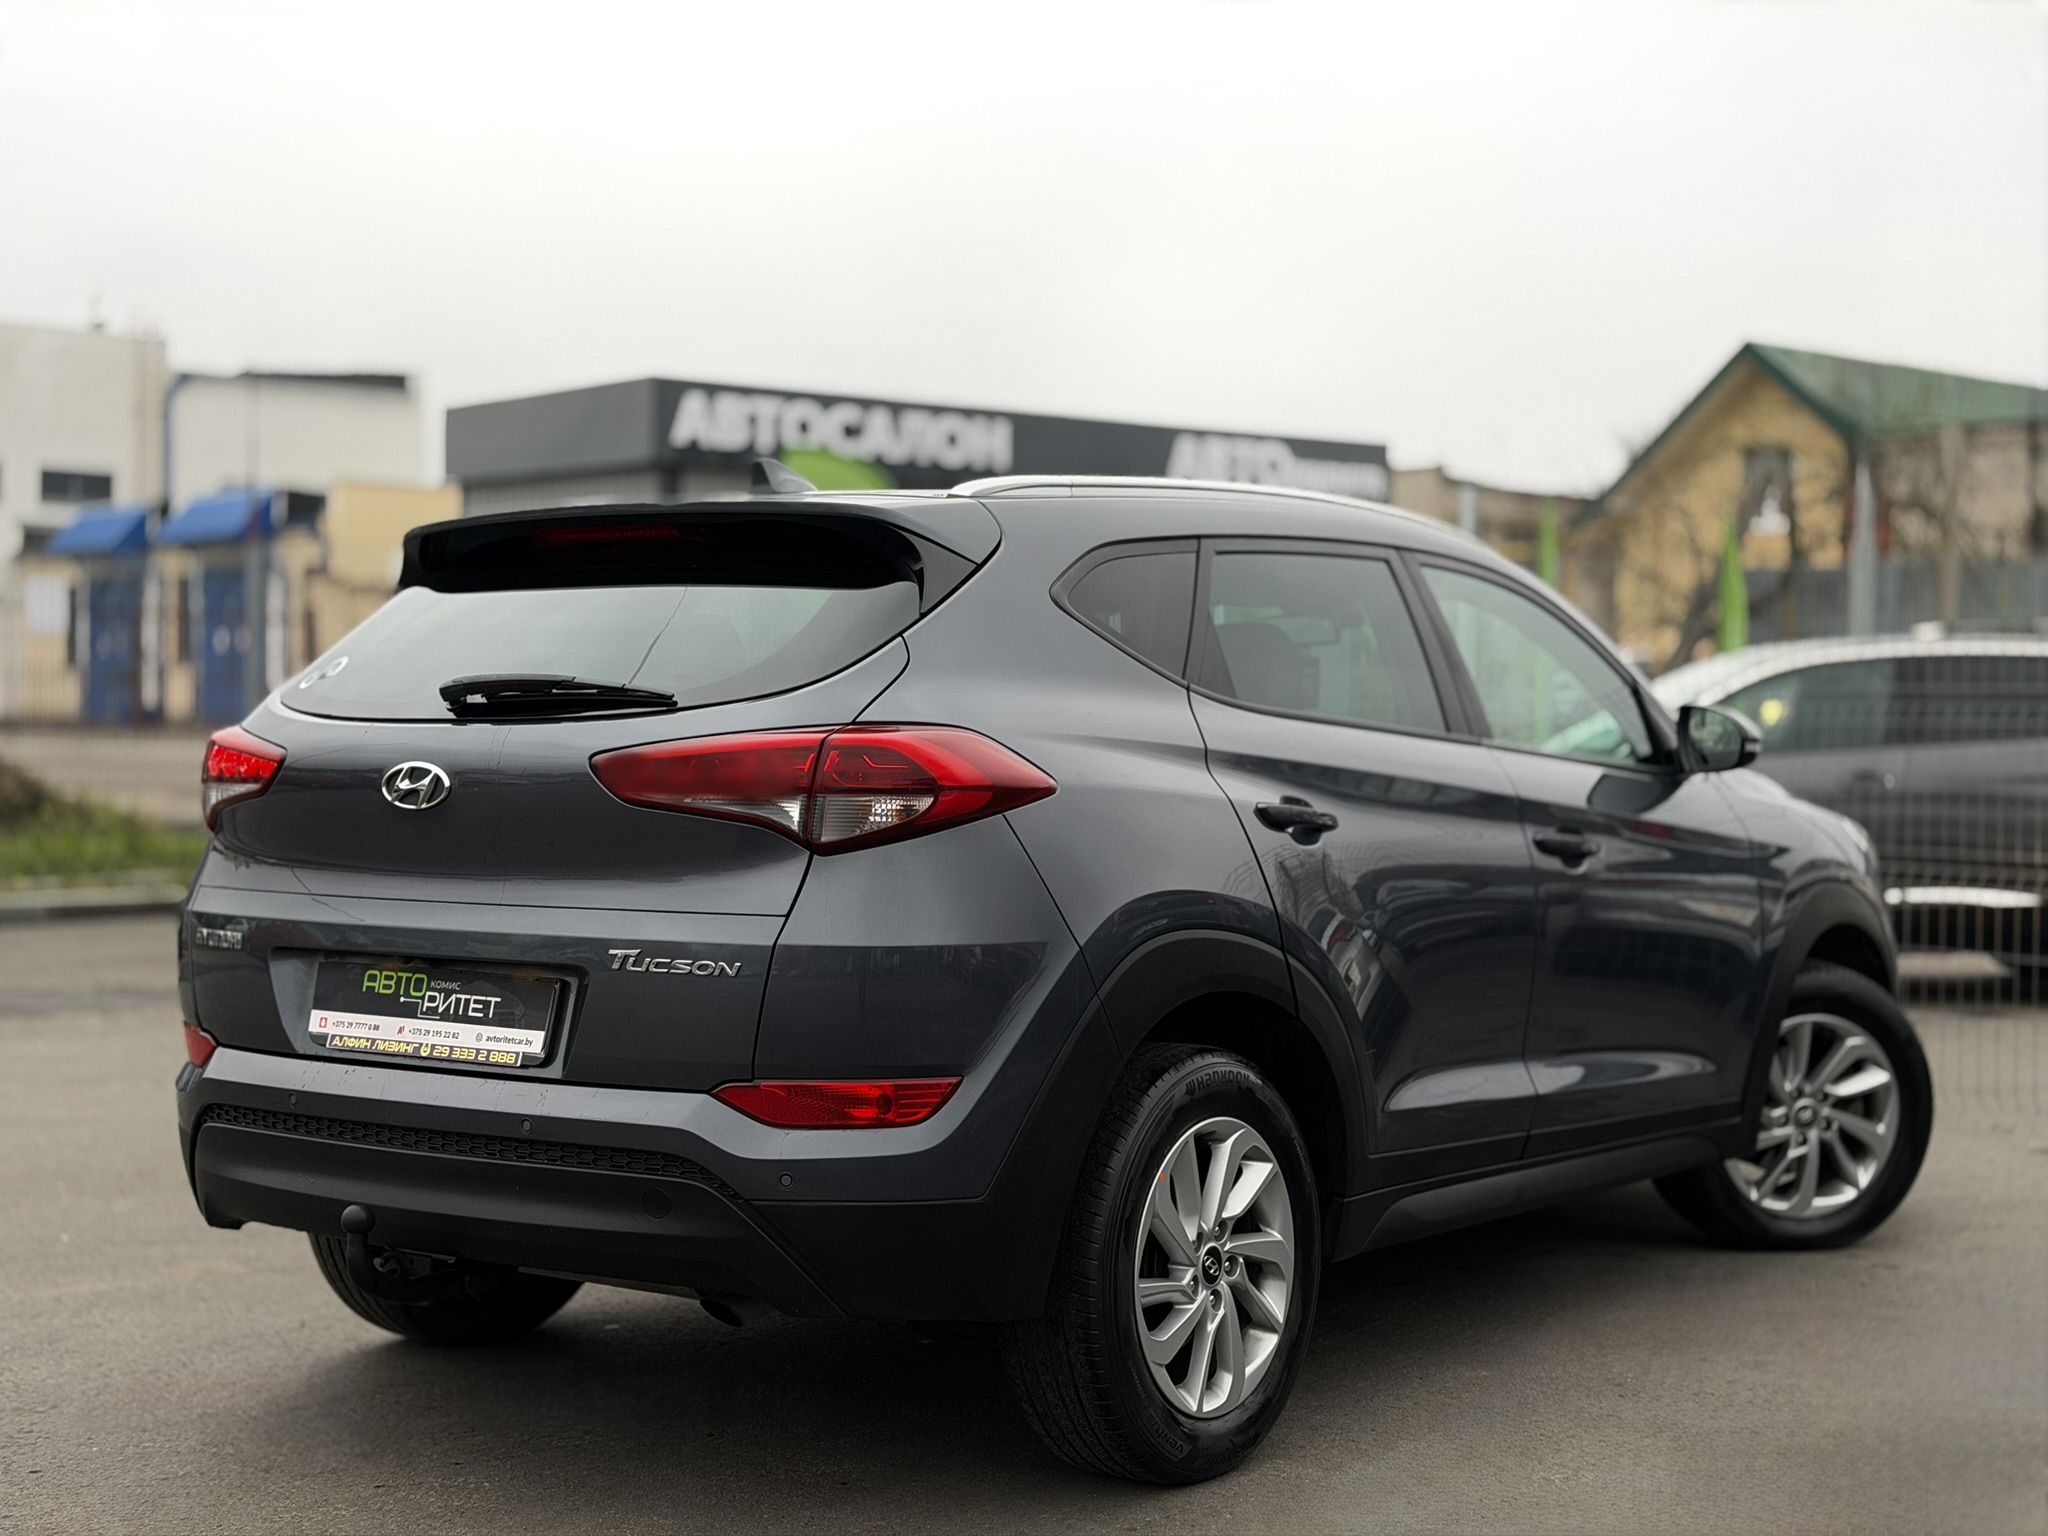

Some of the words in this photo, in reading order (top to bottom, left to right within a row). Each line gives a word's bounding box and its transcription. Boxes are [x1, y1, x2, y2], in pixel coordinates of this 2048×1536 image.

[669, 388, 1014, 473] АВТОСАЛОН
[608, 949, 742, 977] TUCSON
[362, 969, 428, 997] АВТО
[430, 979, 462, 991] КОМИС
[423, 991, 502, 1018] РИТЕТ
[332, 1020, 346, 1029] +375
[346, 1021, 354, 1030] 29
[408, 1027, 423, 1036] +375
[423, 1028, 431, 1037] 29
[431, 1029, 443, 1038] 195
[443, 1030, 451, 1039] 22
[451, 1031, 460, 1040] 82
[331, 1035, 371, 1049] АЛФИН
[372, 1039, 419, 1054] ЛИЗИНГ
[485, 1034, 534, 1048] avtoritetcar.by
[432, 1046, 449, 1057] 29
[451, 1048, 476, 1060] 333
[477, 1050, 488, 1061] 2
[489, 1052, 516, 1064] 888
